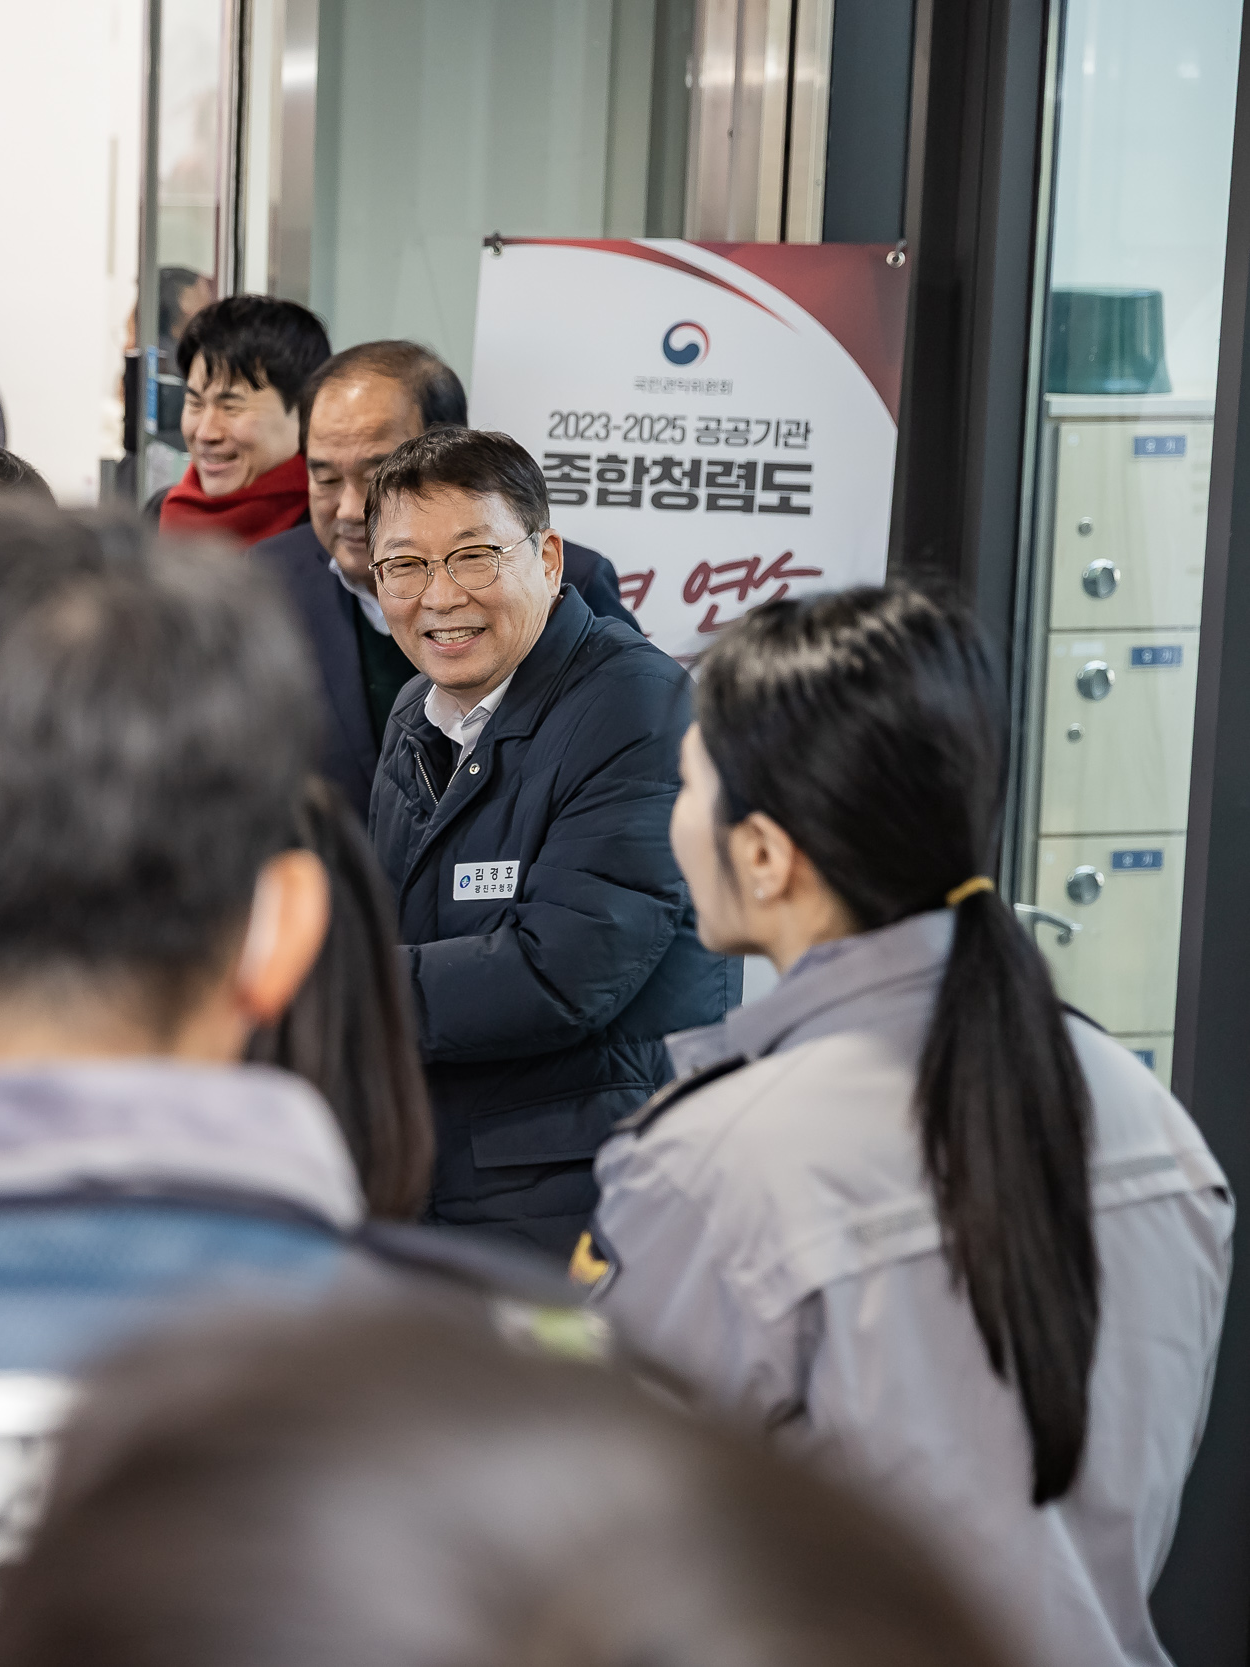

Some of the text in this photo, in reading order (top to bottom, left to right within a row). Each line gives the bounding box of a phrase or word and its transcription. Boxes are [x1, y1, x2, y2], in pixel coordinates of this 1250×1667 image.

[548, 411, 813, 449] 2023-2025 공공기관
[543, 453, 812, 515] 종합청렴도
[474, 884, 514, 894] 광진구청장
